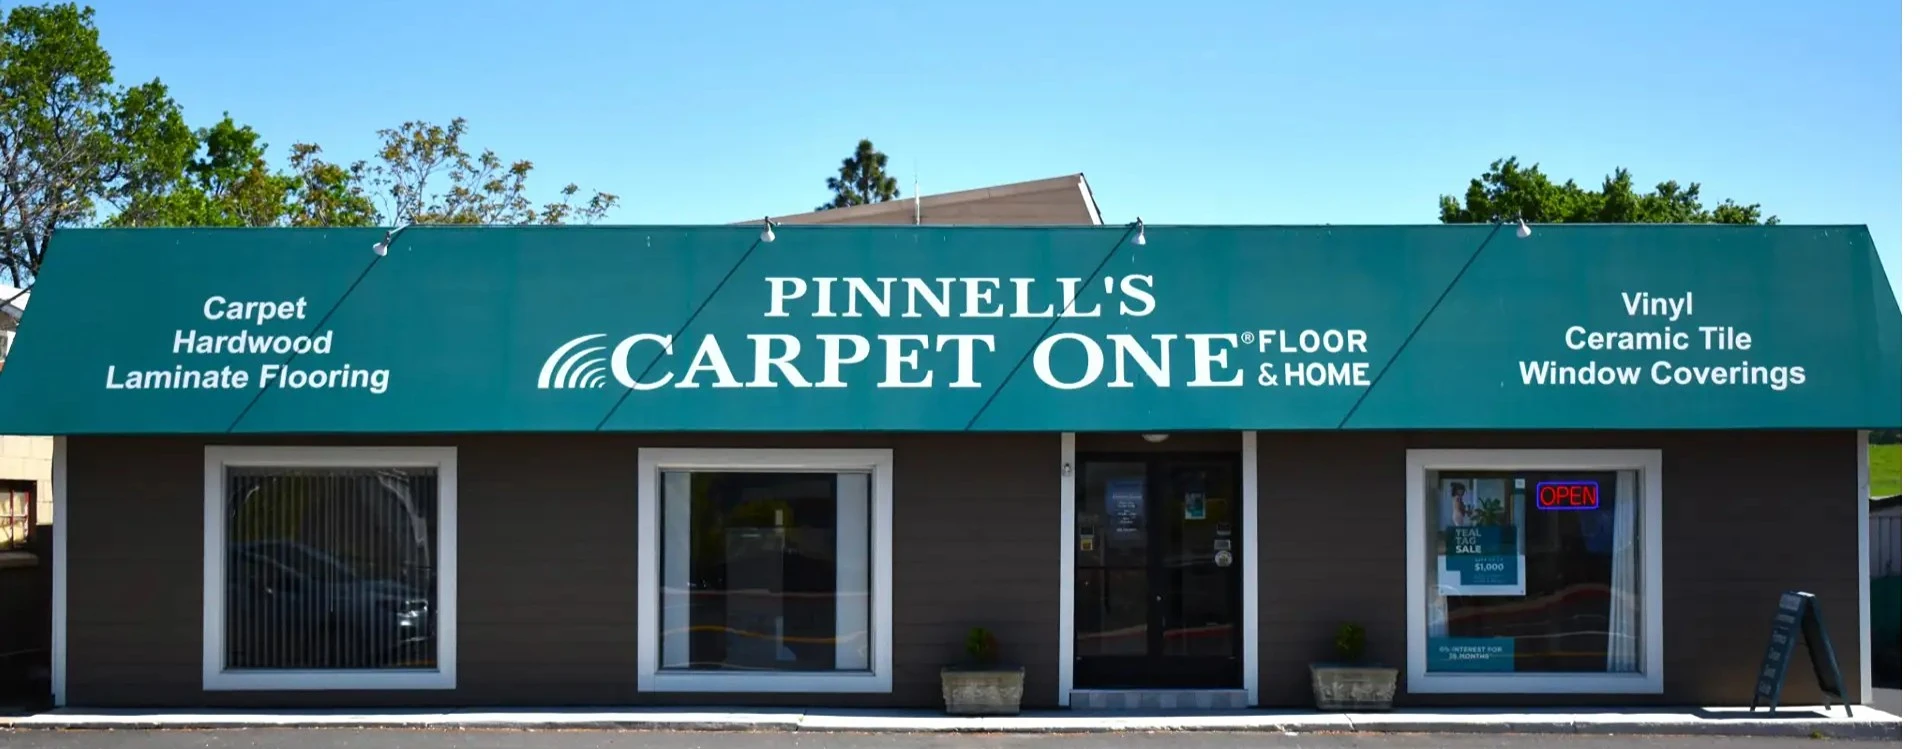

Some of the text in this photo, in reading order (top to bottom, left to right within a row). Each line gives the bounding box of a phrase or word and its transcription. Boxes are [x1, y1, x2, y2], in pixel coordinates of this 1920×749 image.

[764, 274, 1156, 318] PINNELL'S
[1621, 291, 1693, 322] Vinyl
[203, 296, 307, 325] Carpet
[173, 329, 333, 354] Hardwood
[1258, 329, 1368, 353] FLOOR
[1564, 325, 1752, 350] Ceramic Tile
[610, 333, 996, 391] CARPET
[106, 364, 390, 394] Laminate Flooring
[1257, 363, 1371, 387] & HOME
[1519, 360, 1806, 391] Window Coverings
[1539, 485, 1597, 506] OPEN
[1455, 528, 1482, 537] TEAL
[1455, 537, 1476, 545] TAG
[1455, 545, 1482, 554] SALE
[1474, 563, 1505, 572] $1,000
